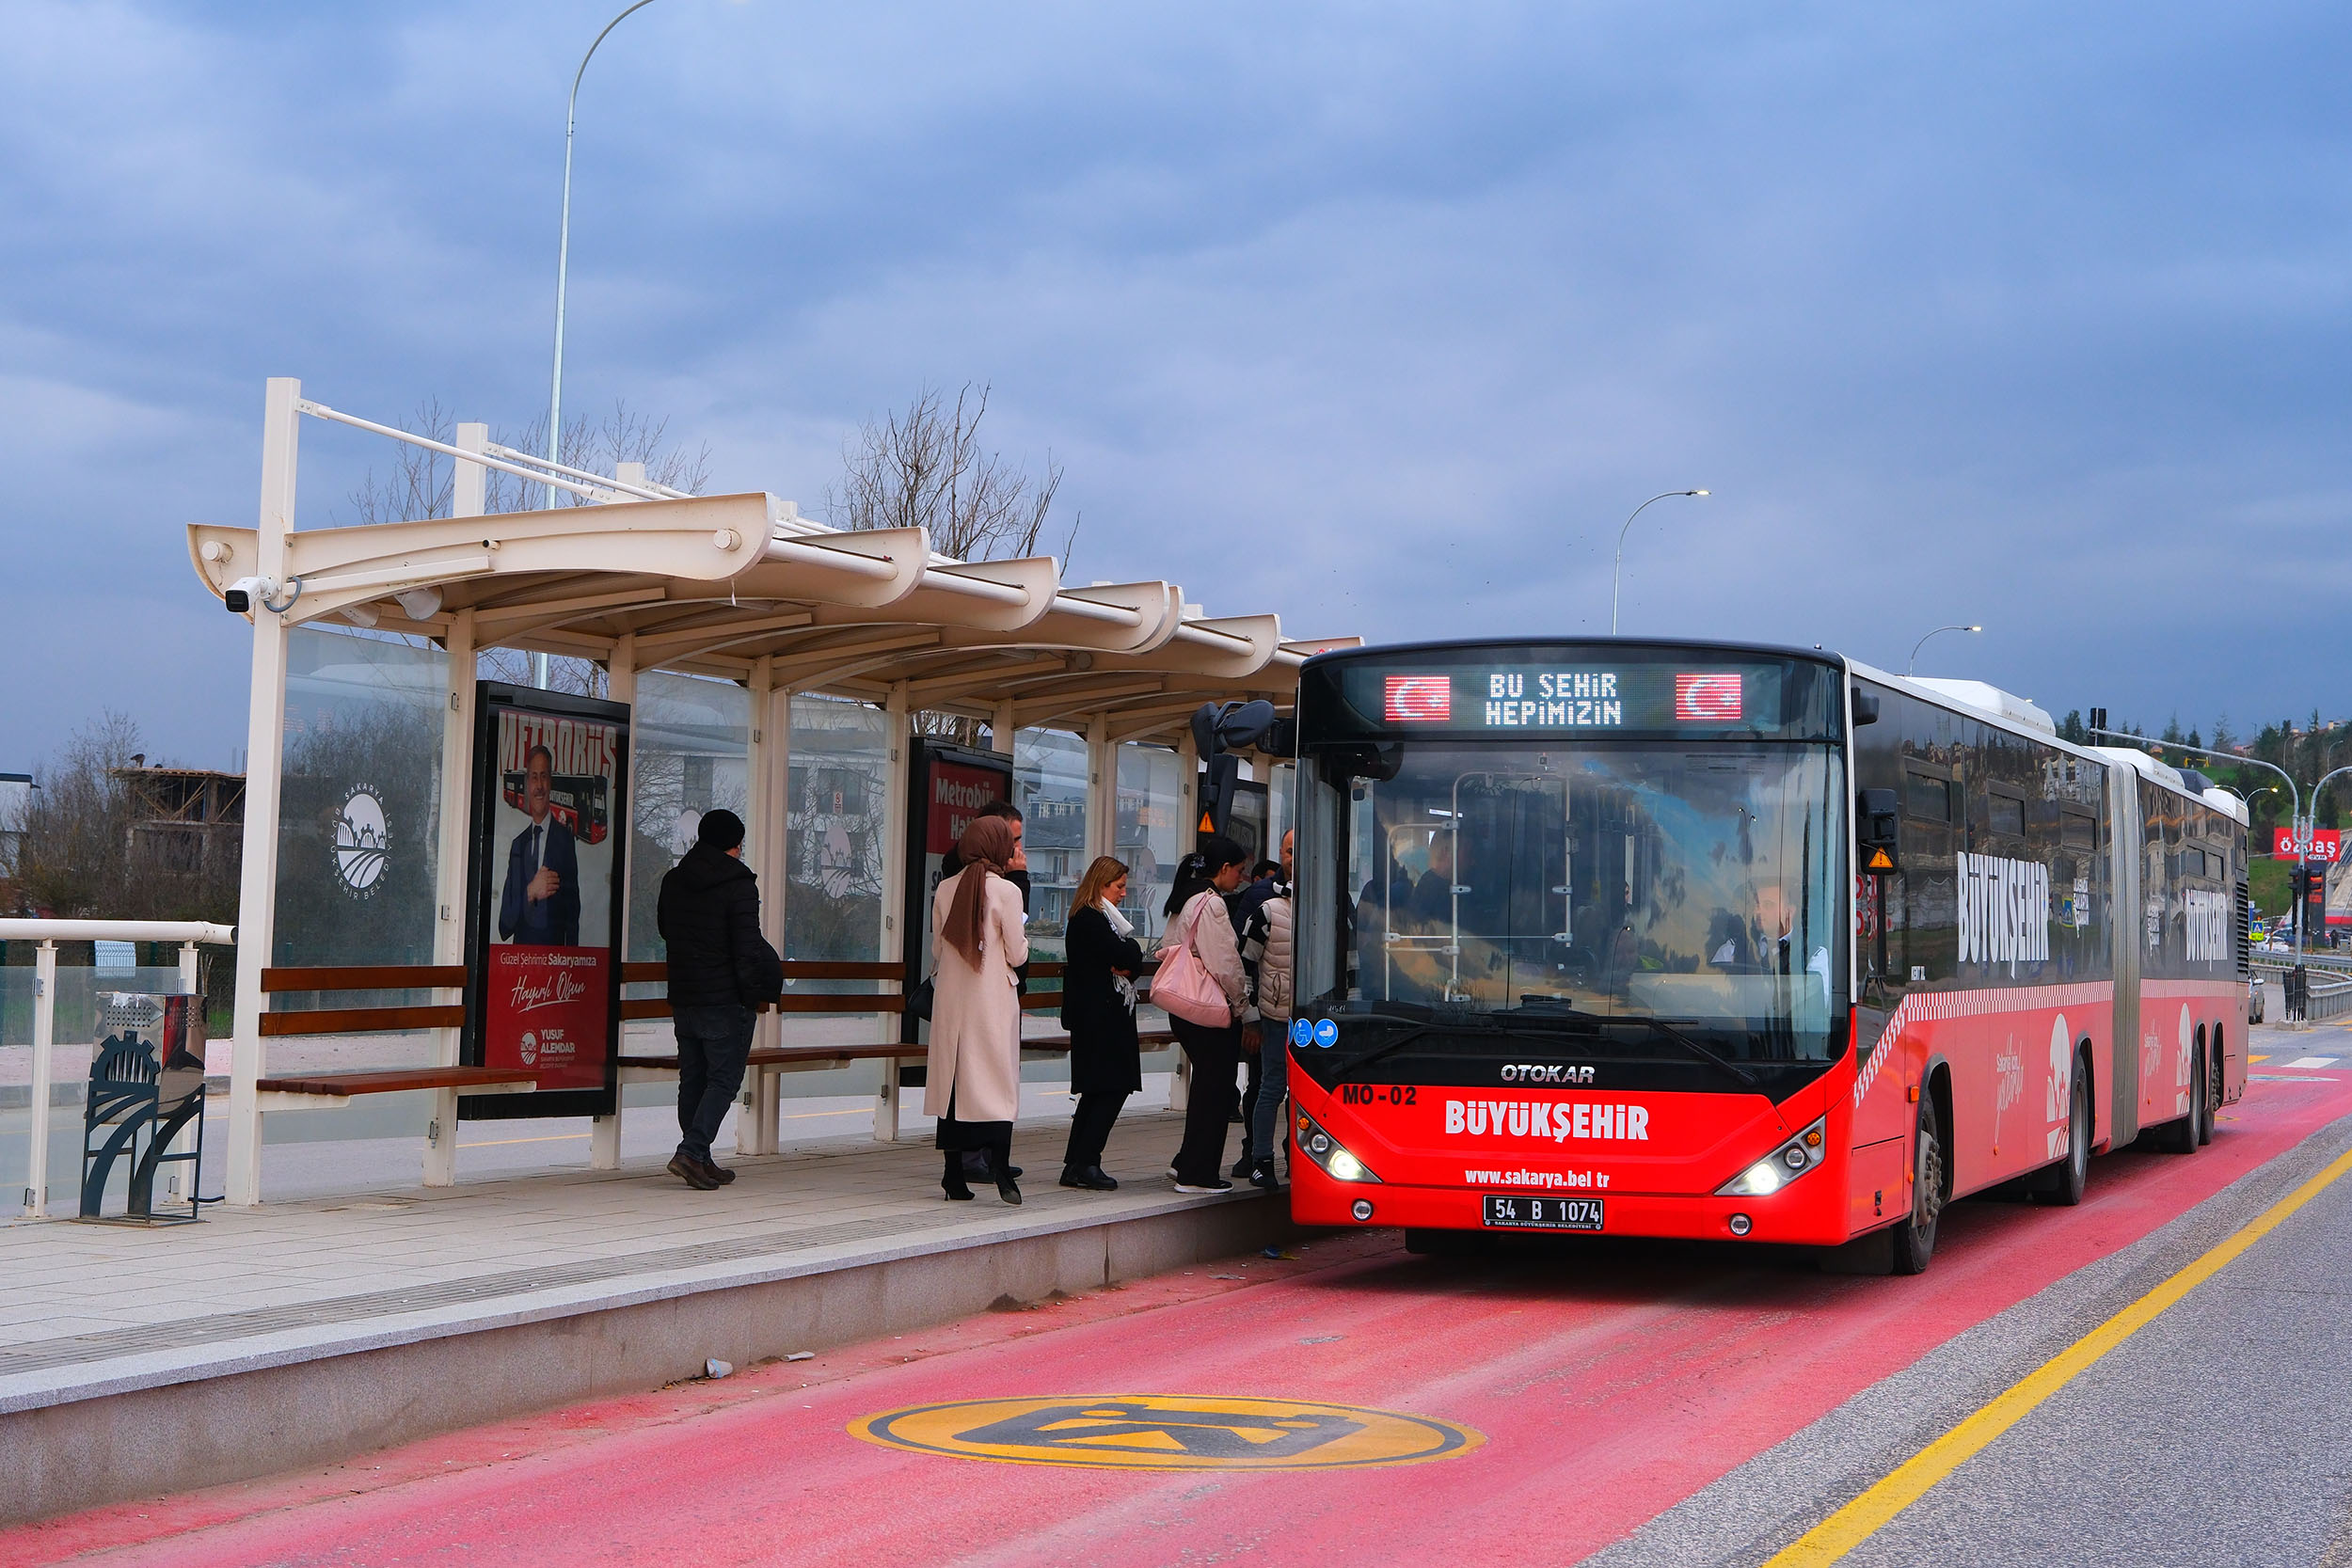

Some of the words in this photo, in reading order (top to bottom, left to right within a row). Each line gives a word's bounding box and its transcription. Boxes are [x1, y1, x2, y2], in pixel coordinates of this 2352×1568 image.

[1489, 673, 1523, 698] BU
[1538, 673, 1617, 700] ŞEHİR
[1486, 700, 1622, 725] HEPİMİZİN
[498, 711, 617, 790] METROBÜS
[344, 782, 384, 806] SAKARYA
[1957, 850, 2049, 980] BÜYÜKŞEHİR
[2185, 888, 2228, 972] BÜYÜKŞEHİR
[501, 952, 520, 965] Güzel
[548, 953, 597, 968] Sakaryamıza
[556, 971, 586, 1002] Olsun
[540, 1029, 564, 1040] YUSUF
[540, 1042, 576, 1054] ALEMDAR
[1501, 1064, 1596, 1084] OTOKAR
[1445, 1100, 1649, 1144] BÜYÜKŞEHİR
[1495, 1198, 1517, 1219] 54
[1532, 1200, 1543, 1220] B
[1559, 1201, 1599, 1223] 1074
